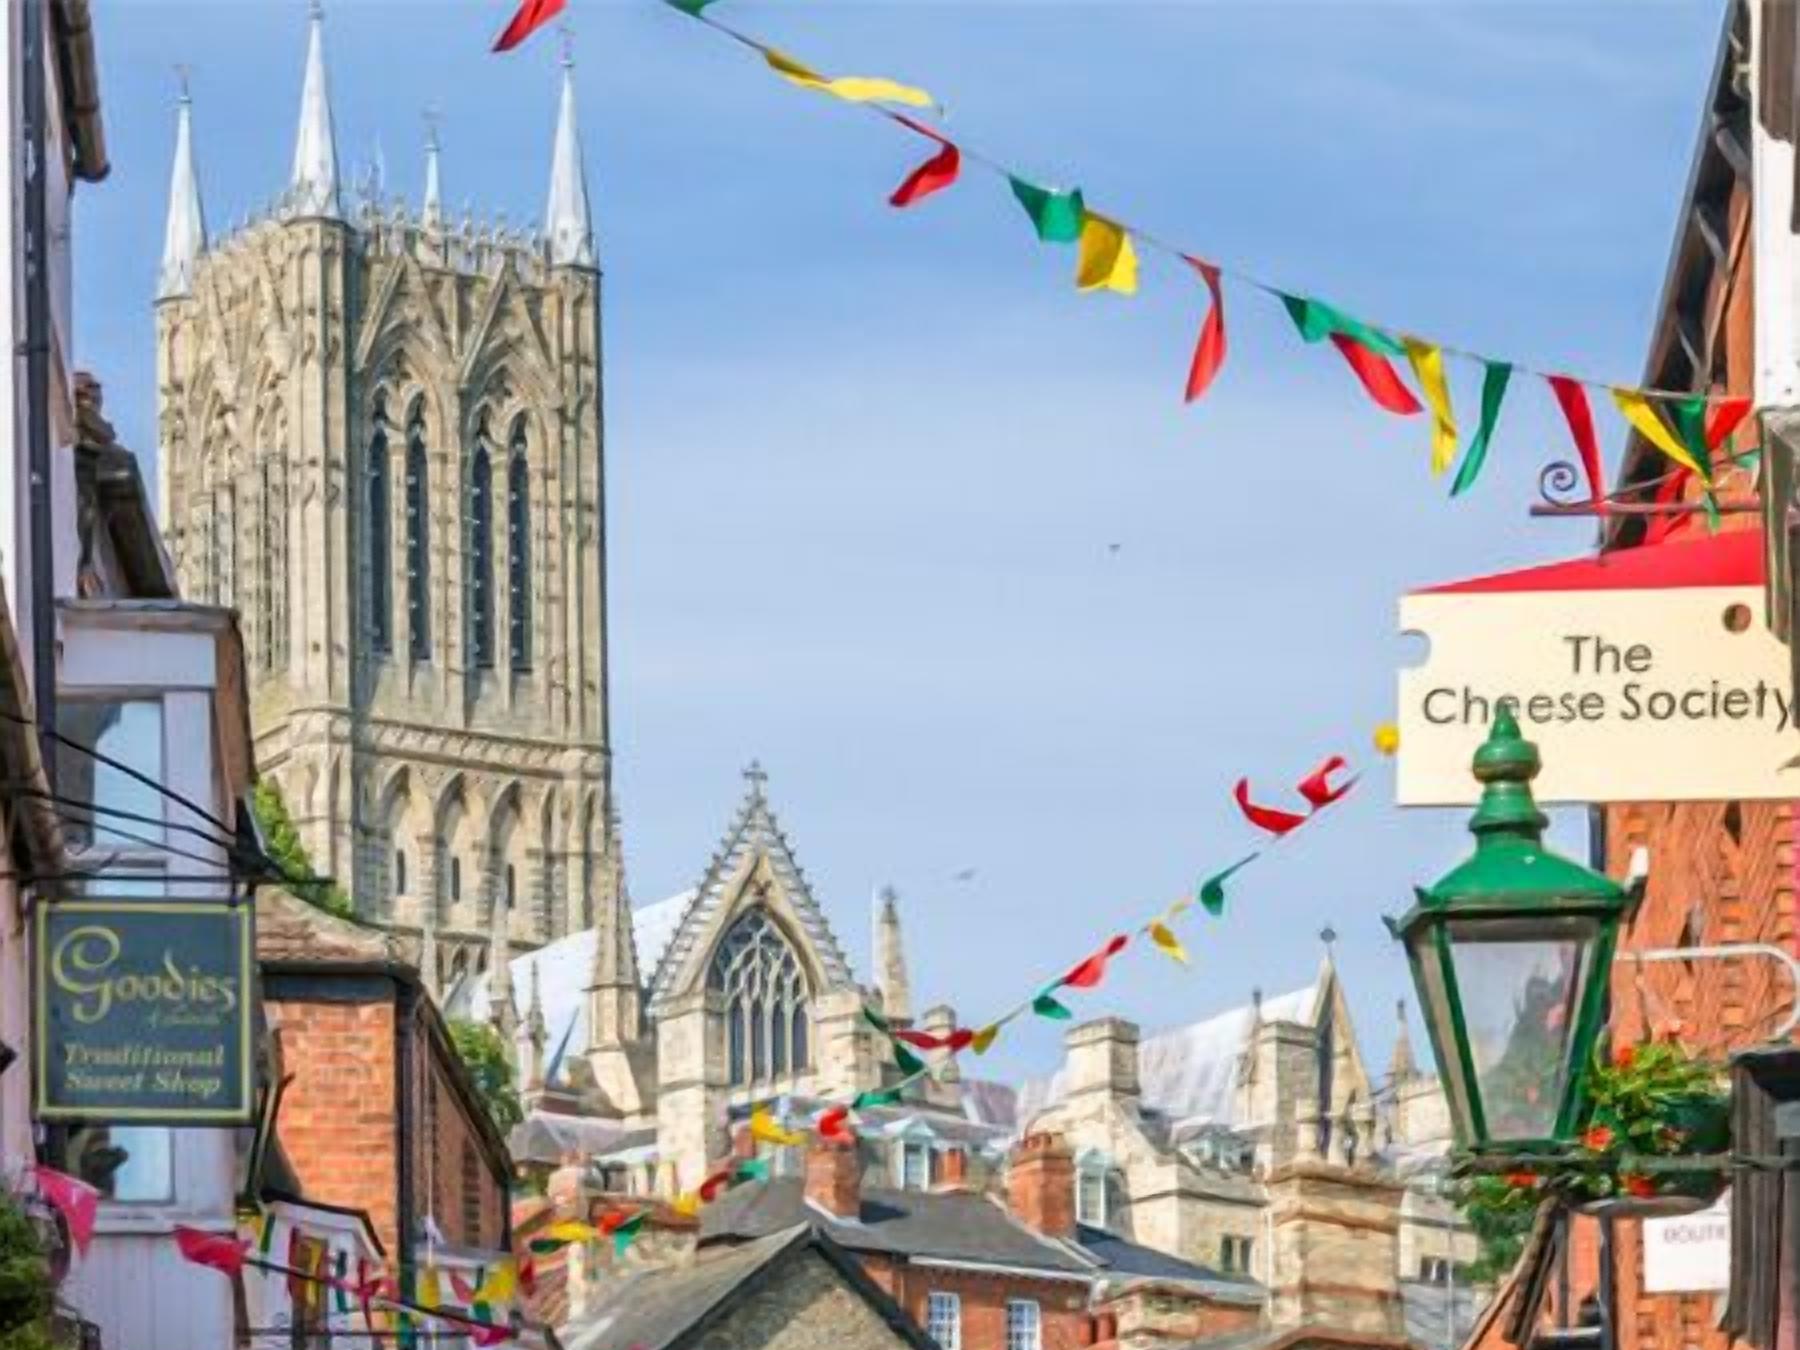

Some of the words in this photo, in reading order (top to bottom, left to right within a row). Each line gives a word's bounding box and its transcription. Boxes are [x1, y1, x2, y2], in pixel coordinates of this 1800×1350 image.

[1563, 634, 1653, 674] The
[1619, 678, 1790, 733] Society
[51, 924, 236, 1024] Goodies
